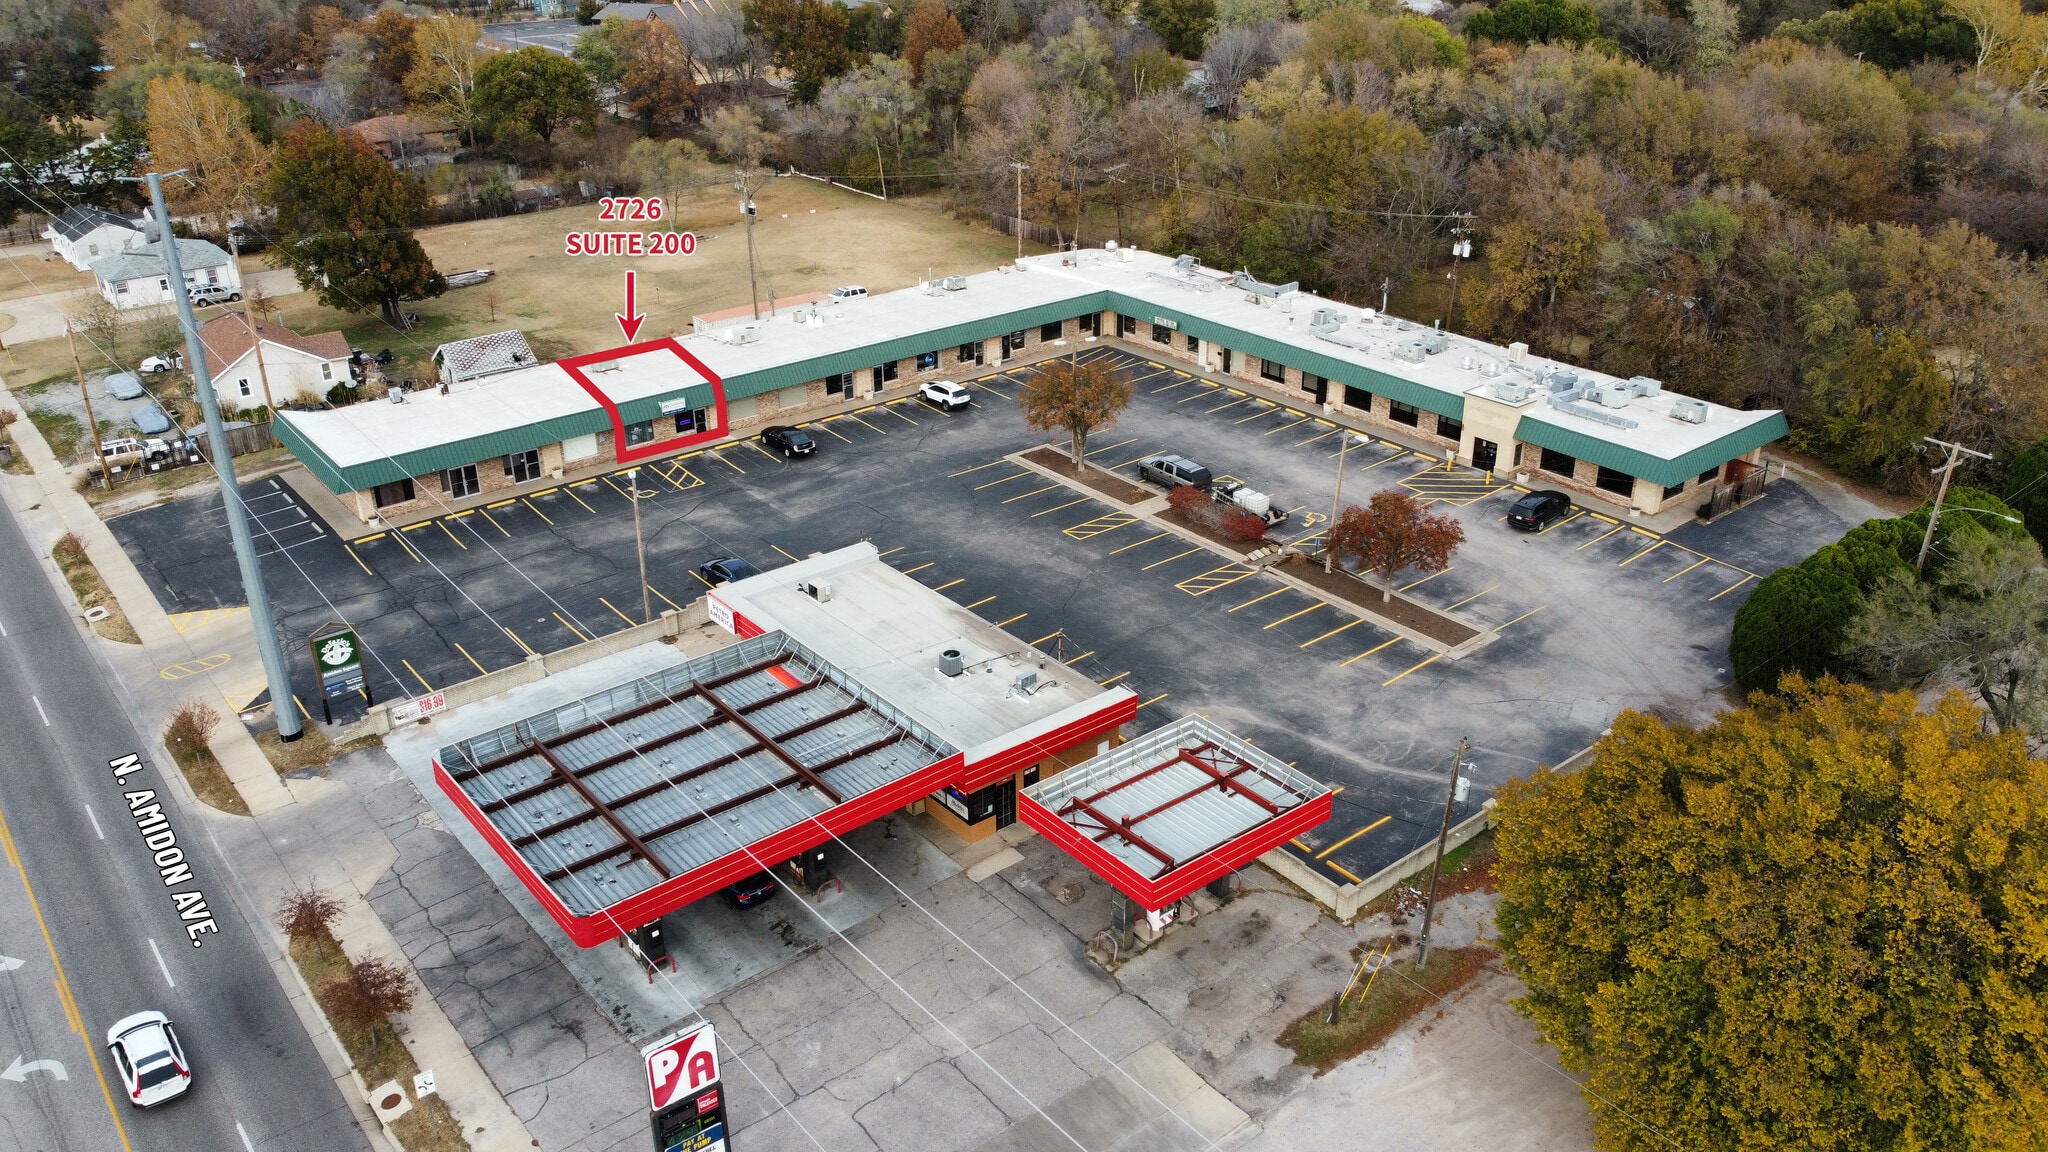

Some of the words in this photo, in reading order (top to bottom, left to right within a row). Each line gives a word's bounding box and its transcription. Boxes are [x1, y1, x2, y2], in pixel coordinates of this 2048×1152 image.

[712, 604, 730, 619] PETRO
[710, 610, 733, 629] AMERICA
[418, 694, 444, 713] $16.99
[683, 1138, 695, 1148] PAY
[694, 1137, 711, 1150] PUMP
